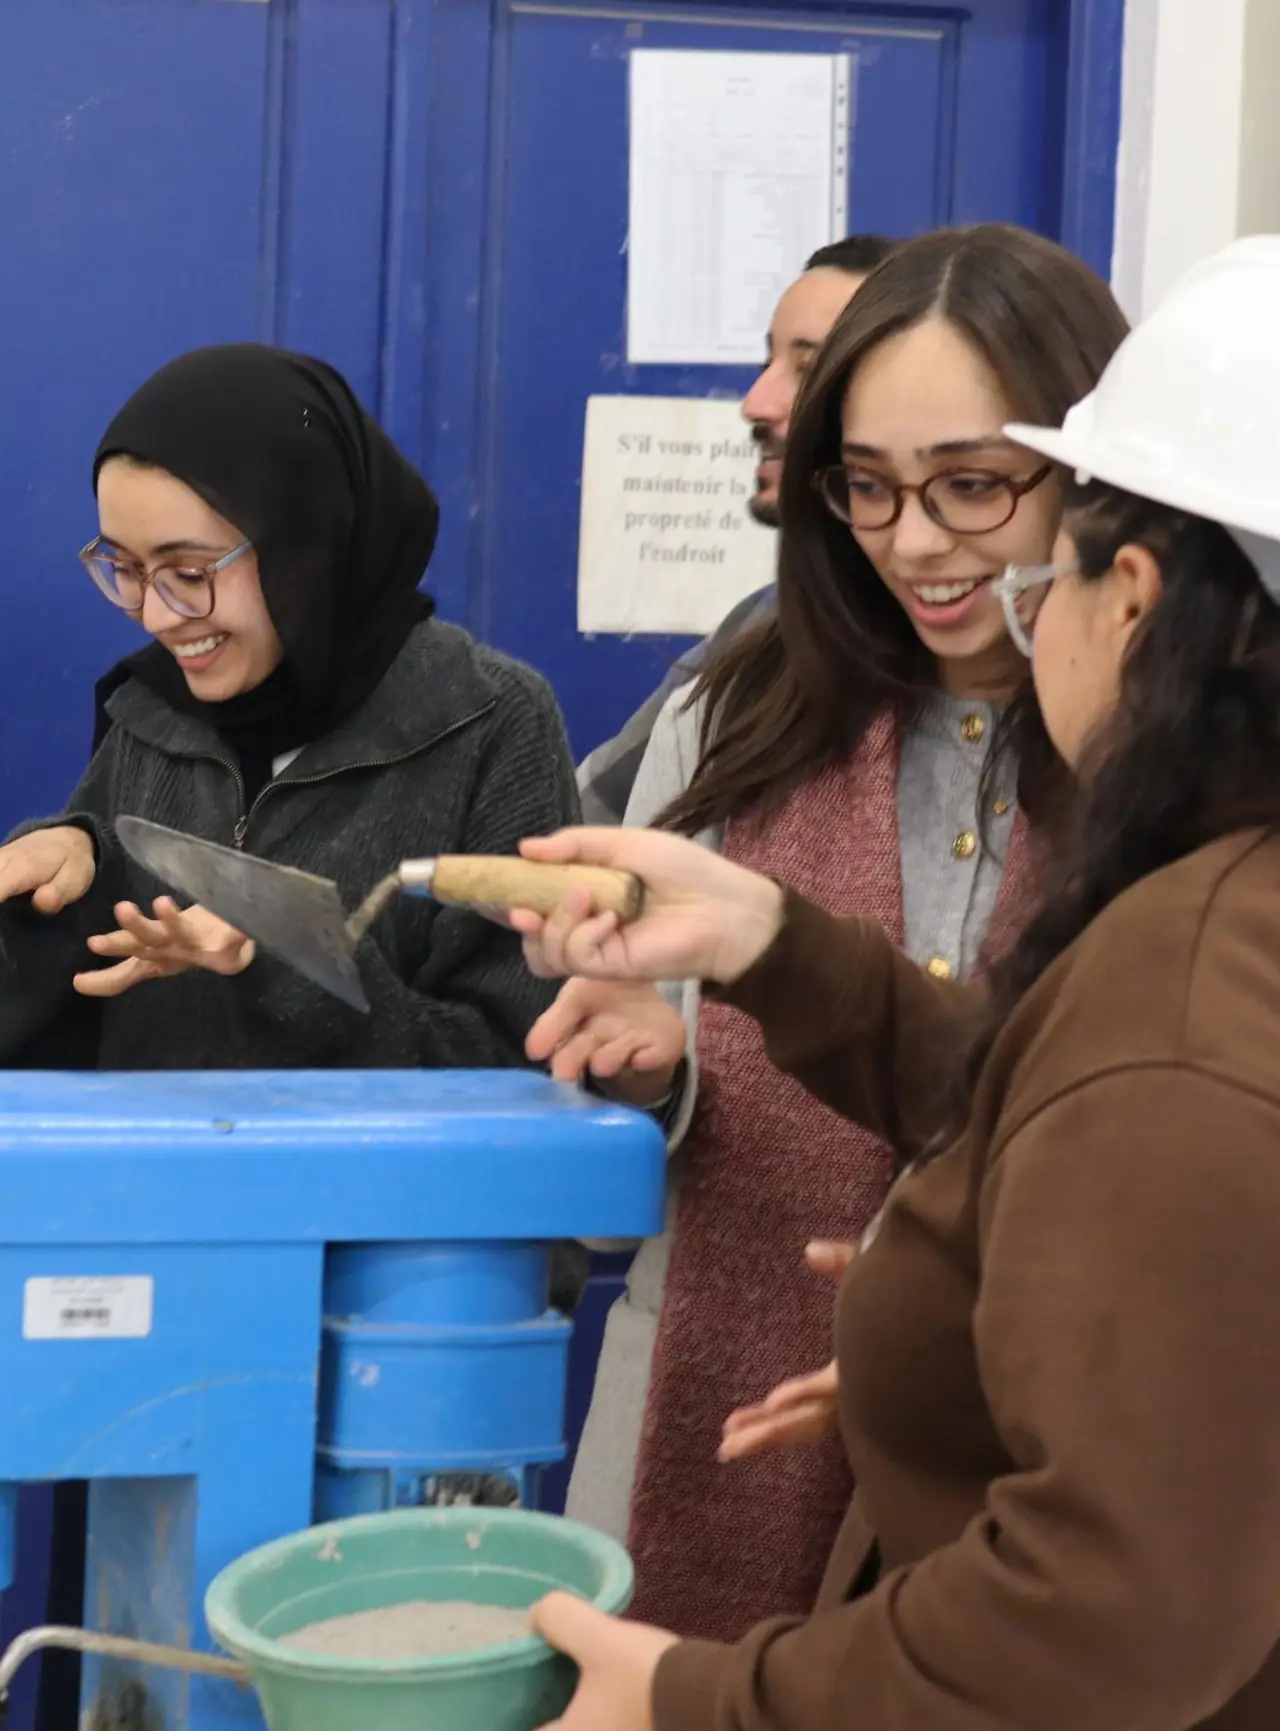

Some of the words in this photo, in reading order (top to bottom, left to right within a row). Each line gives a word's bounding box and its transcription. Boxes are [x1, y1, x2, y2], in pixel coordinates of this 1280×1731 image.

[617, 433, 651, 455] S'il
[657, 440, 703, 456] vous
[622, 473, 723, 495] maintenir
[729, 476, 747, 496] la
[624, 510, 712, 533] propreté
[719, 512, 743, 532] de
[638, 542, 725, 564] l'endroit
